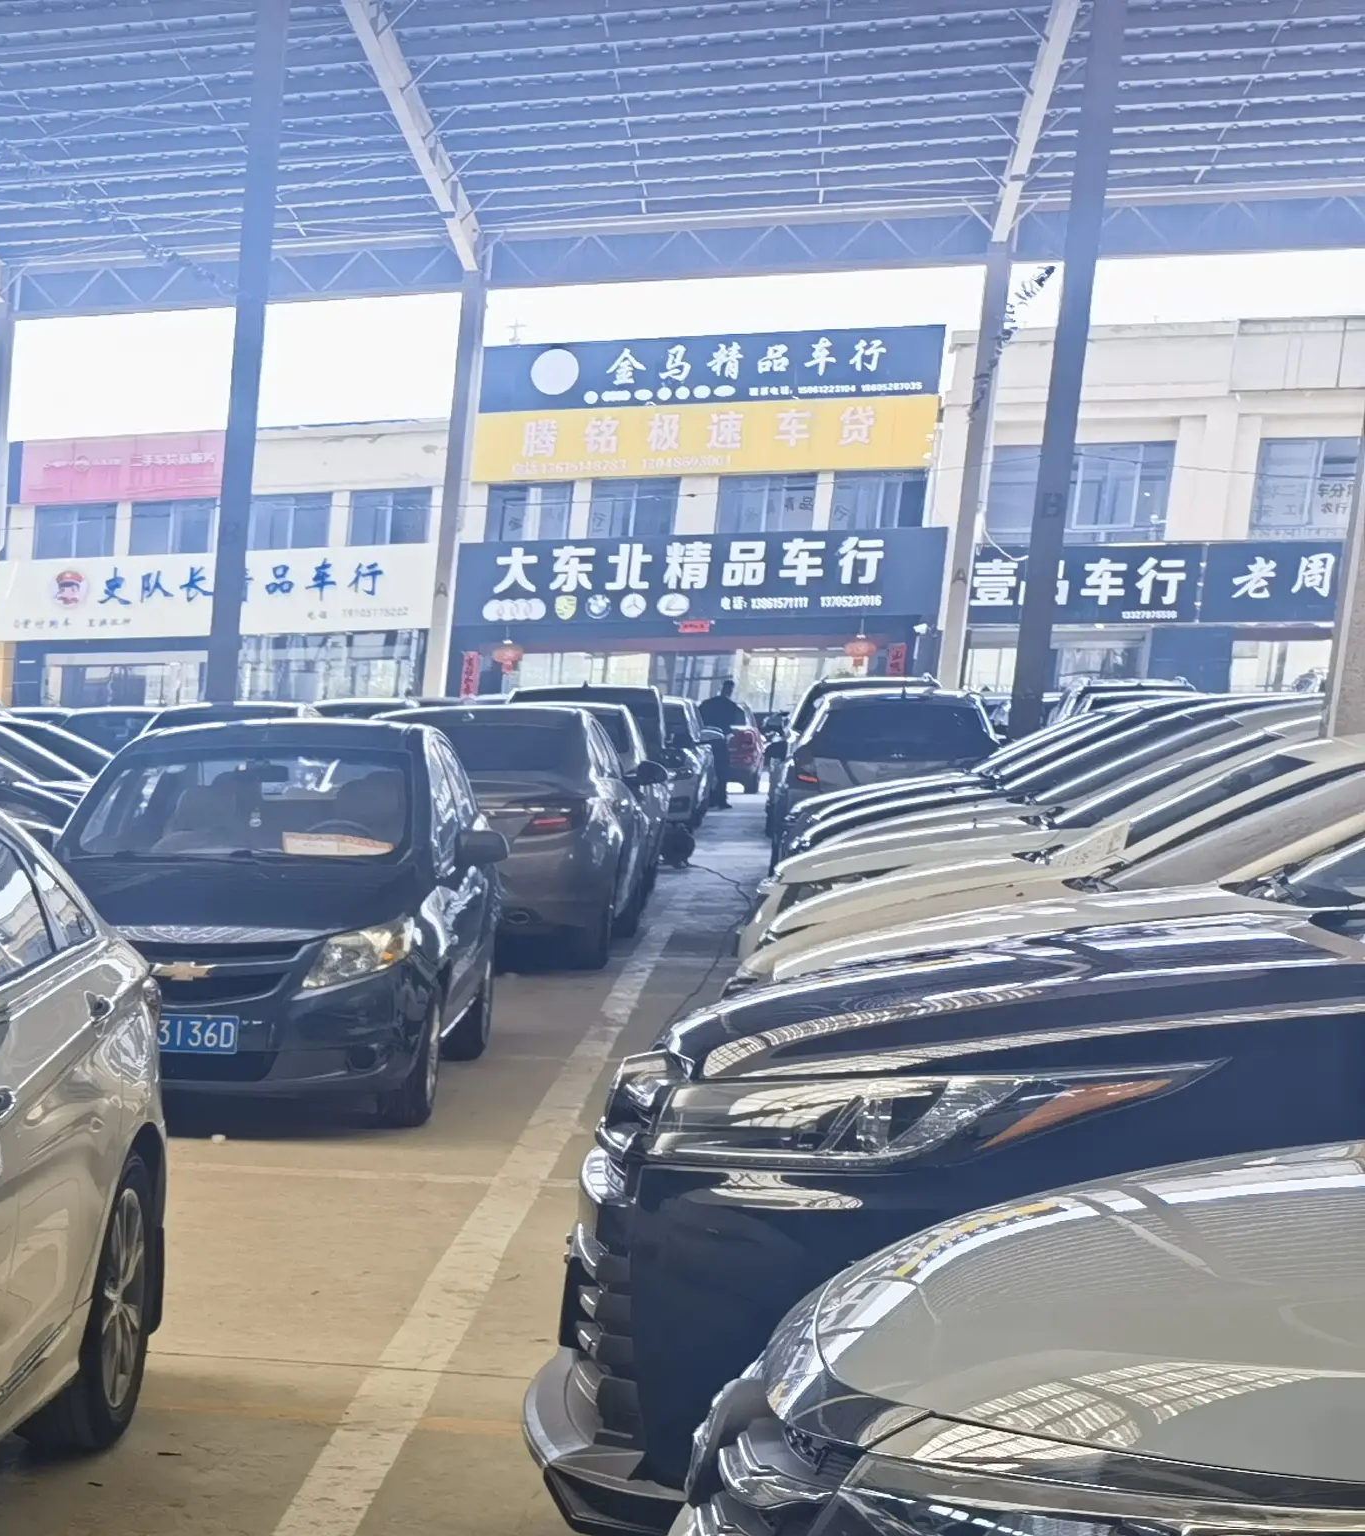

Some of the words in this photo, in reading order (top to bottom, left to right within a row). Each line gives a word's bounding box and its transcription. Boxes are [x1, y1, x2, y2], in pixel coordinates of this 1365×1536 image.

[605, 337, 887, 386] 金马精品车行
[521, 407, 875, 458] 腾铭极速车贷
[493, 536, 886, 593] 大东北精品车行
[969, 557, 1187, 607] 壹车行
[1232, 552, 1336, 600] 老周
